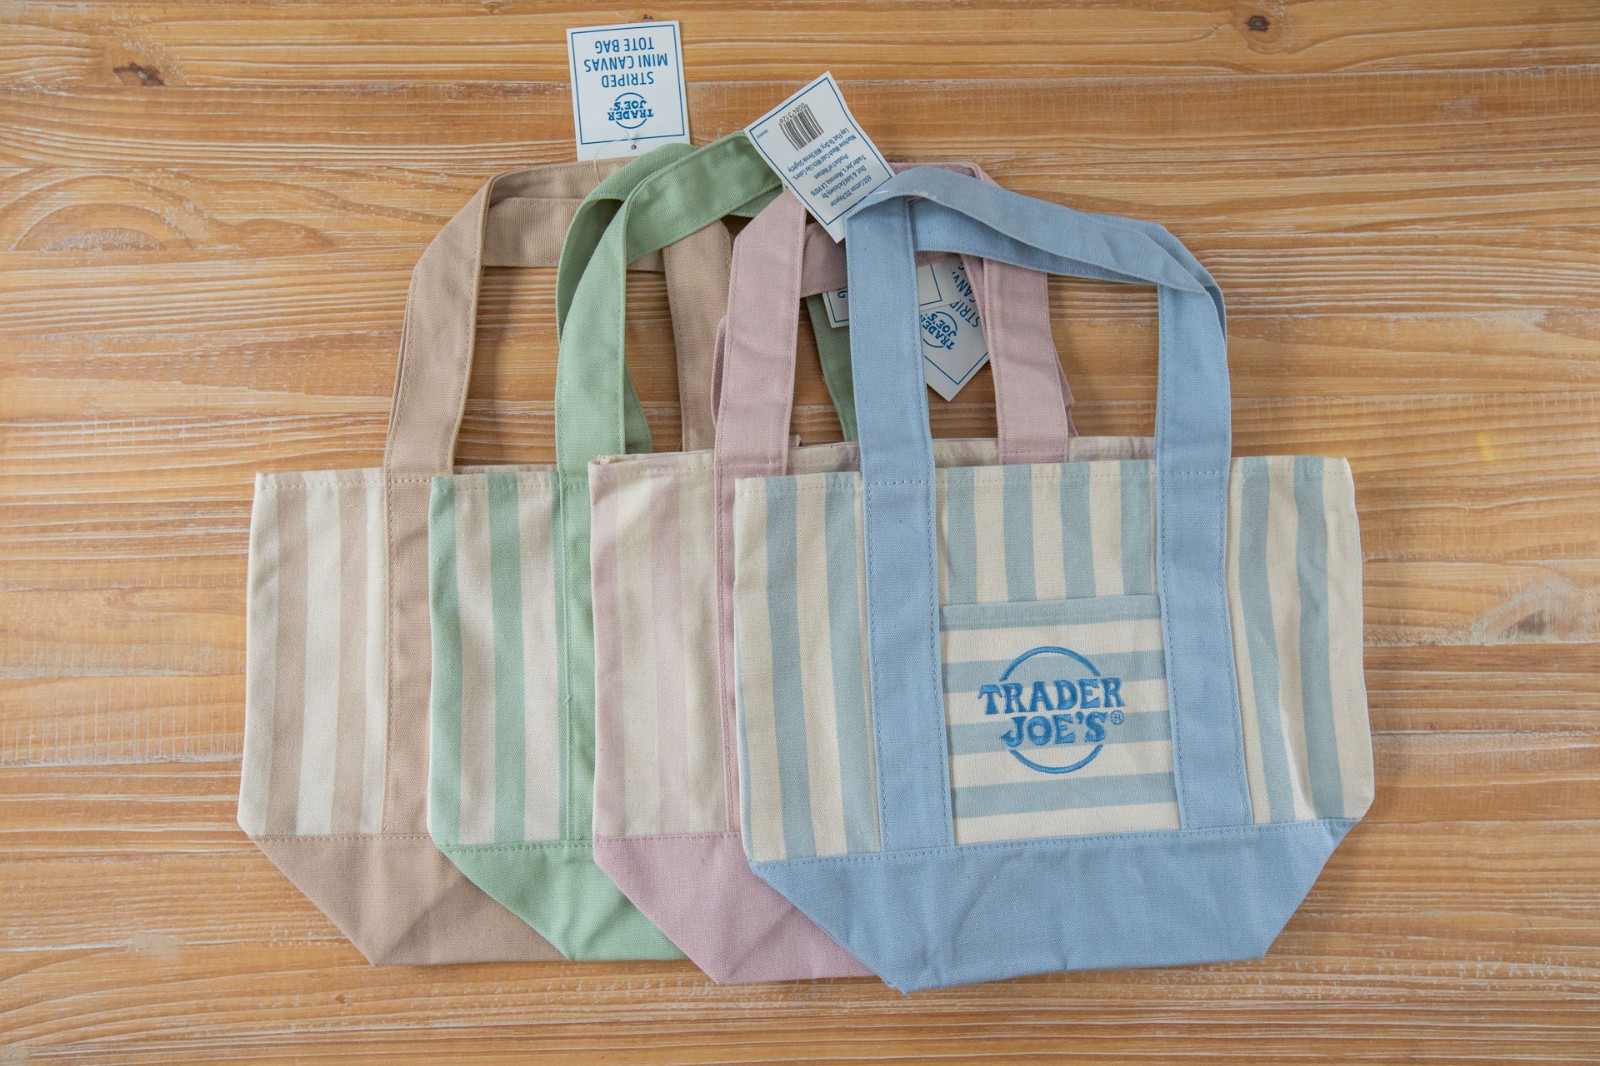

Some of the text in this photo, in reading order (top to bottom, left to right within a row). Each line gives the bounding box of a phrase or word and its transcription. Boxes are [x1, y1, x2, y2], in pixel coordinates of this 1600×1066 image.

[594, 36, 654, 54] TOTE BAG
[584, 53, 668, 72] MINI CANVAS
[601, 72, 654, 88] STRIPED
[608, 109, 654, 120] TRADER
[832, 132, 842, 142] Flat
[839, 127, 849, 135] Lay
[838, 134, 856, 148] Machine
[813, 147, 822, 156] Will
[827, 144, 840, 156] Wash
[802, 152, 815, 163] Shrink
[812, 158, 822, 168] With
[820, 152, 830, 162] Cold
[831, 152, 849, 168] Product
[851, 154, 866, 166] Trader
[786, 159, 804, 173] Slightly
[804, 164, 814, 172] Like
[813, 166, 829, 179] Vietnam
[843, 173, 853, 184] Sold
[826, 180, 846, 196] Exclusively
[849, 179, 864, 192] Cotton
[829, 193, 846, 207] Polyester
[950, 302, 980, 328] STRIP
[978, 677, 1125, 715] TRADER
